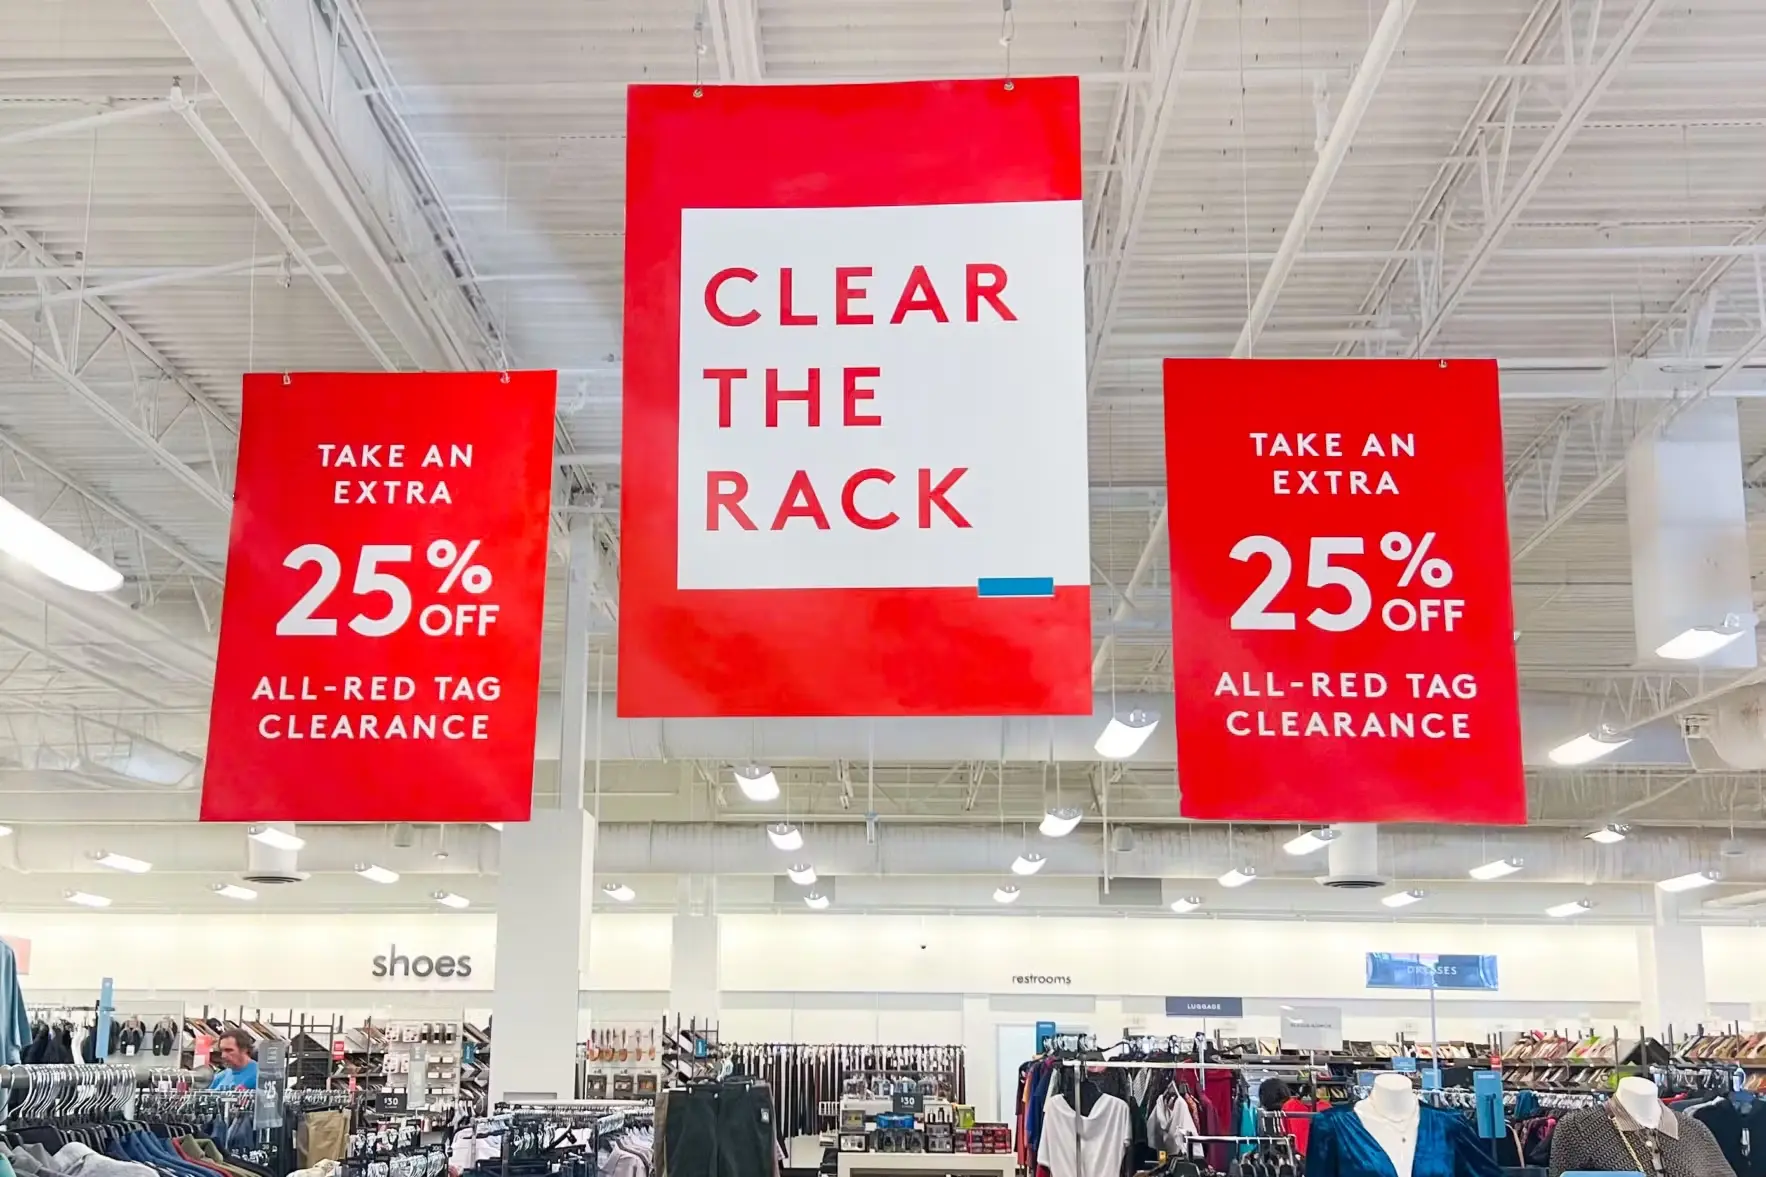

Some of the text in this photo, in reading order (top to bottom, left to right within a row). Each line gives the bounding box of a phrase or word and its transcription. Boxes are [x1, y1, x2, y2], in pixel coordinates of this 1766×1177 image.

[703, 263, 1018, 327] CLEAR
[703, 366, 882, 428] THE
[318, 444, 473, 468] TAKE AN
[1250, 432, 1415, 457] TAKE AN
[334, 480, 452, 504] EXTRA
[1273, 470, 1399, 495] EXTRA
[706, 467, 972, 531] RACK
[419, 604, 500, 637] OFF
[1381, 598, 1464, 632] OFF
[252, 676, 501, 701] ALL-RED TAG
[1214, 671, 1477, 699] ALL-RED TAG
[258, 714, 489, 740] CLEARANCE
[1226, 710, 1470, 739] CLEARANCE
[372, 944, 472, 978] shoes
[1012, 973, 1072, 984] restrooms
[383, 1096, 399, 1106] $30
[901, 1096, 915, 1105] $30
